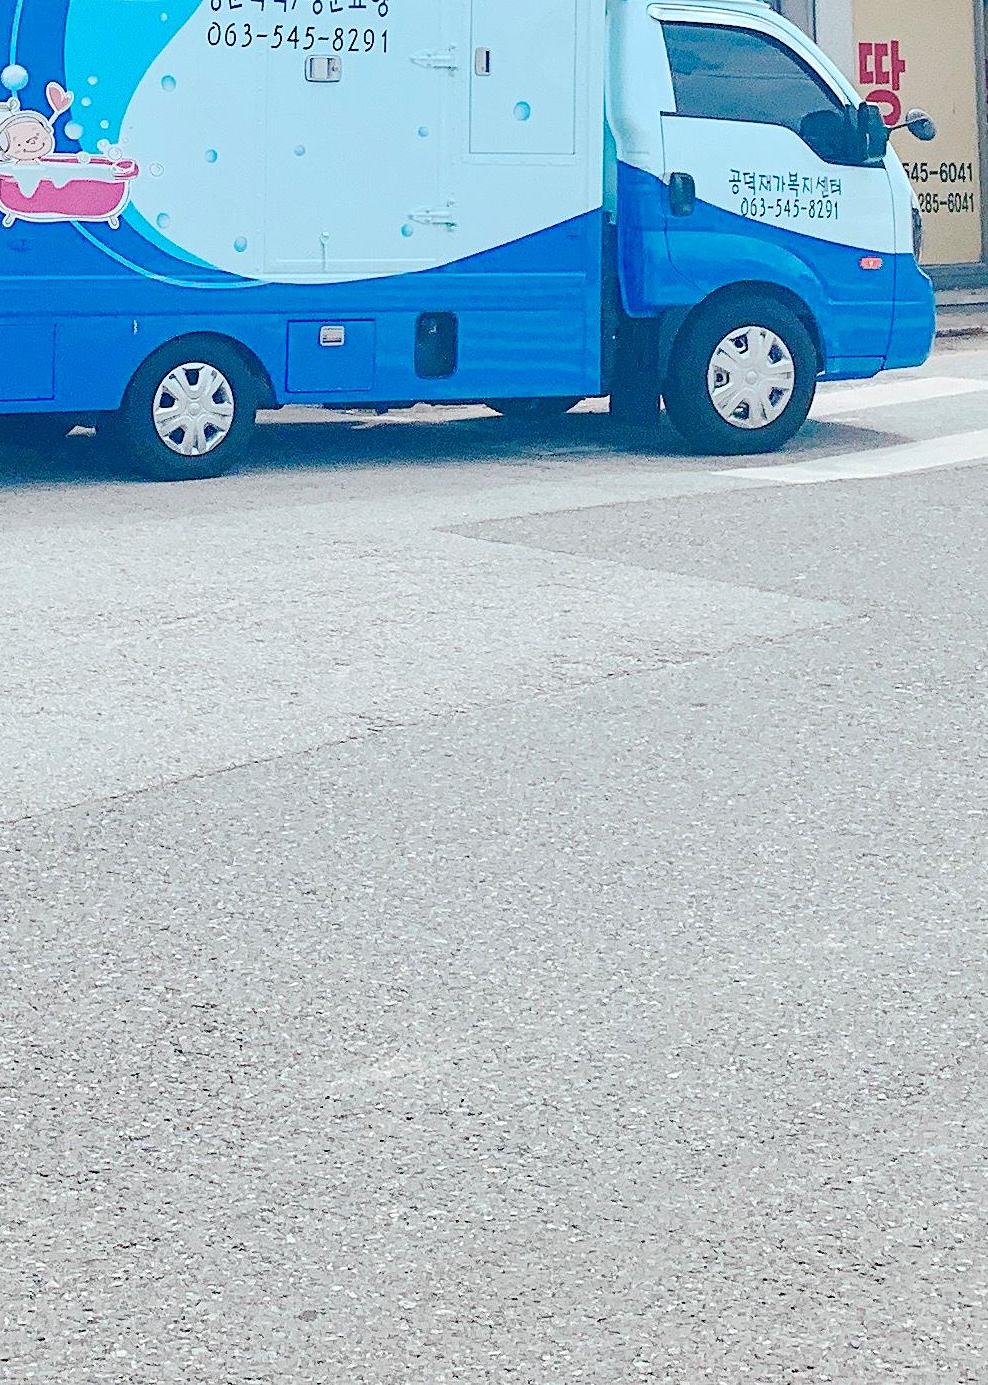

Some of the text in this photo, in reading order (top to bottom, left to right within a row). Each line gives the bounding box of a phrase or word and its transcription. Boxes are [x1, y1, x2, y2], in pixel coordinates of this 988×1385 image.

[207, 22, 388, 53] 063-545-8291
[858, 40, 906, 128] 땅
[728, 169, 842, 200] 공덕재가복지센터
[740, 197, 839, 221] 063-545-8291
